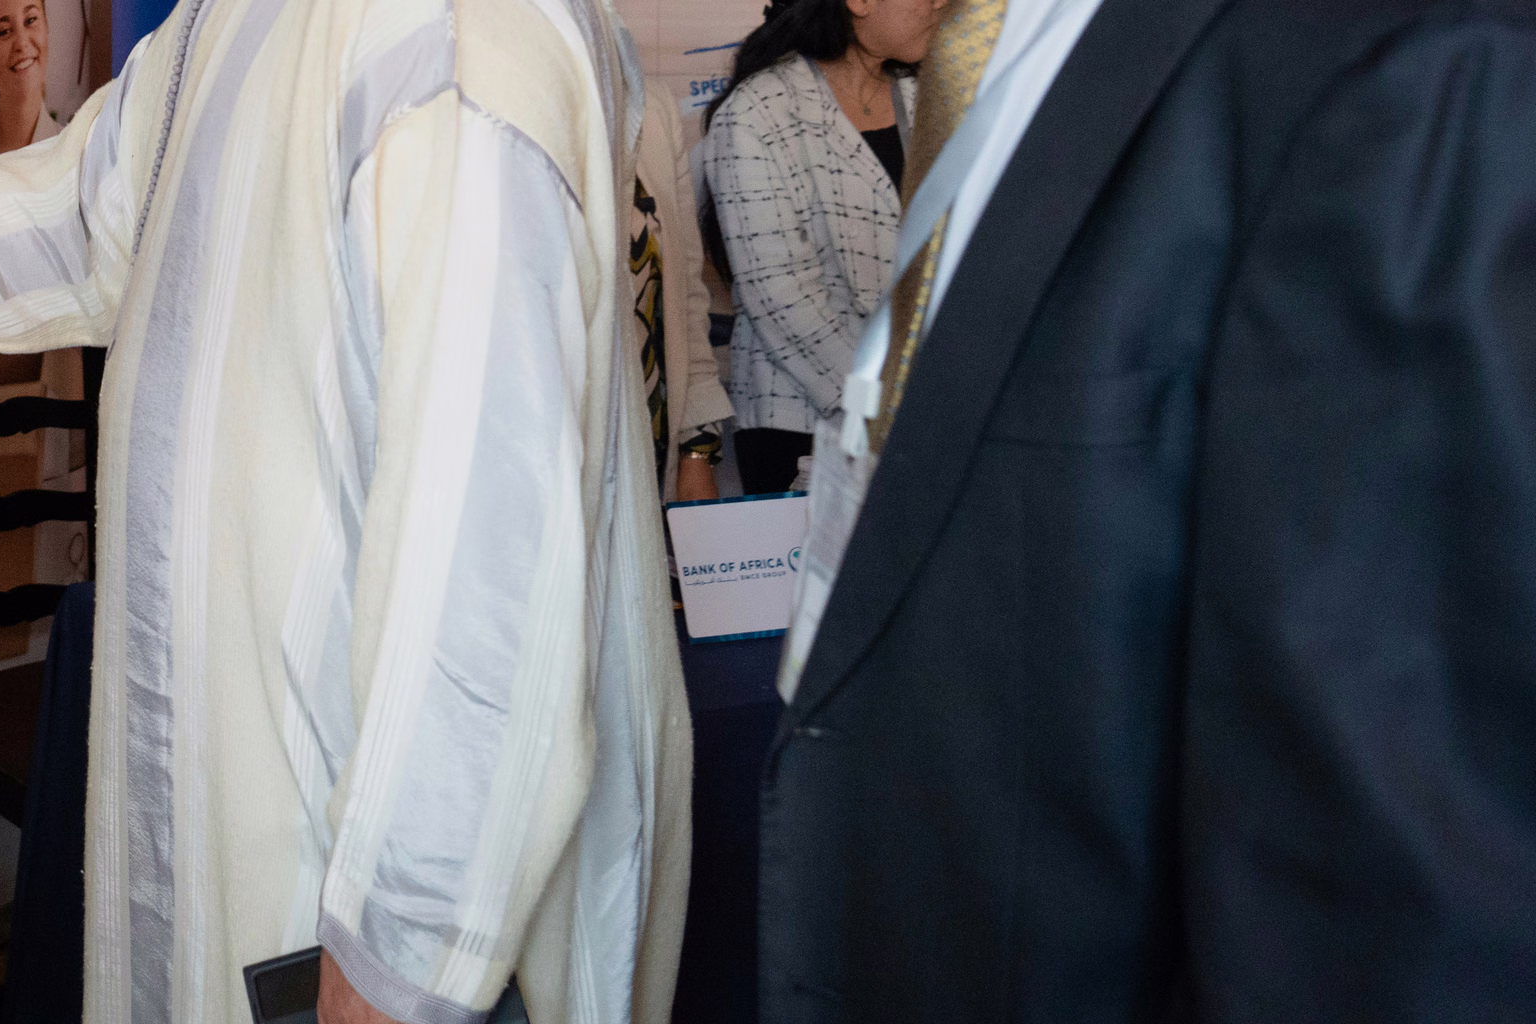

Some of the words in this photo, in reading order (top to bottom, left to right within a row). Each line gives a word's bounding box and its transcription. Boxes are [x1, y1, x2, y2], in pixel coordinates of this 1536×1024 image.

[682, 564, 716, 577] BANK
[720, 562, 735, 573] OF
[739, 558, 785, 572] AFRICA
